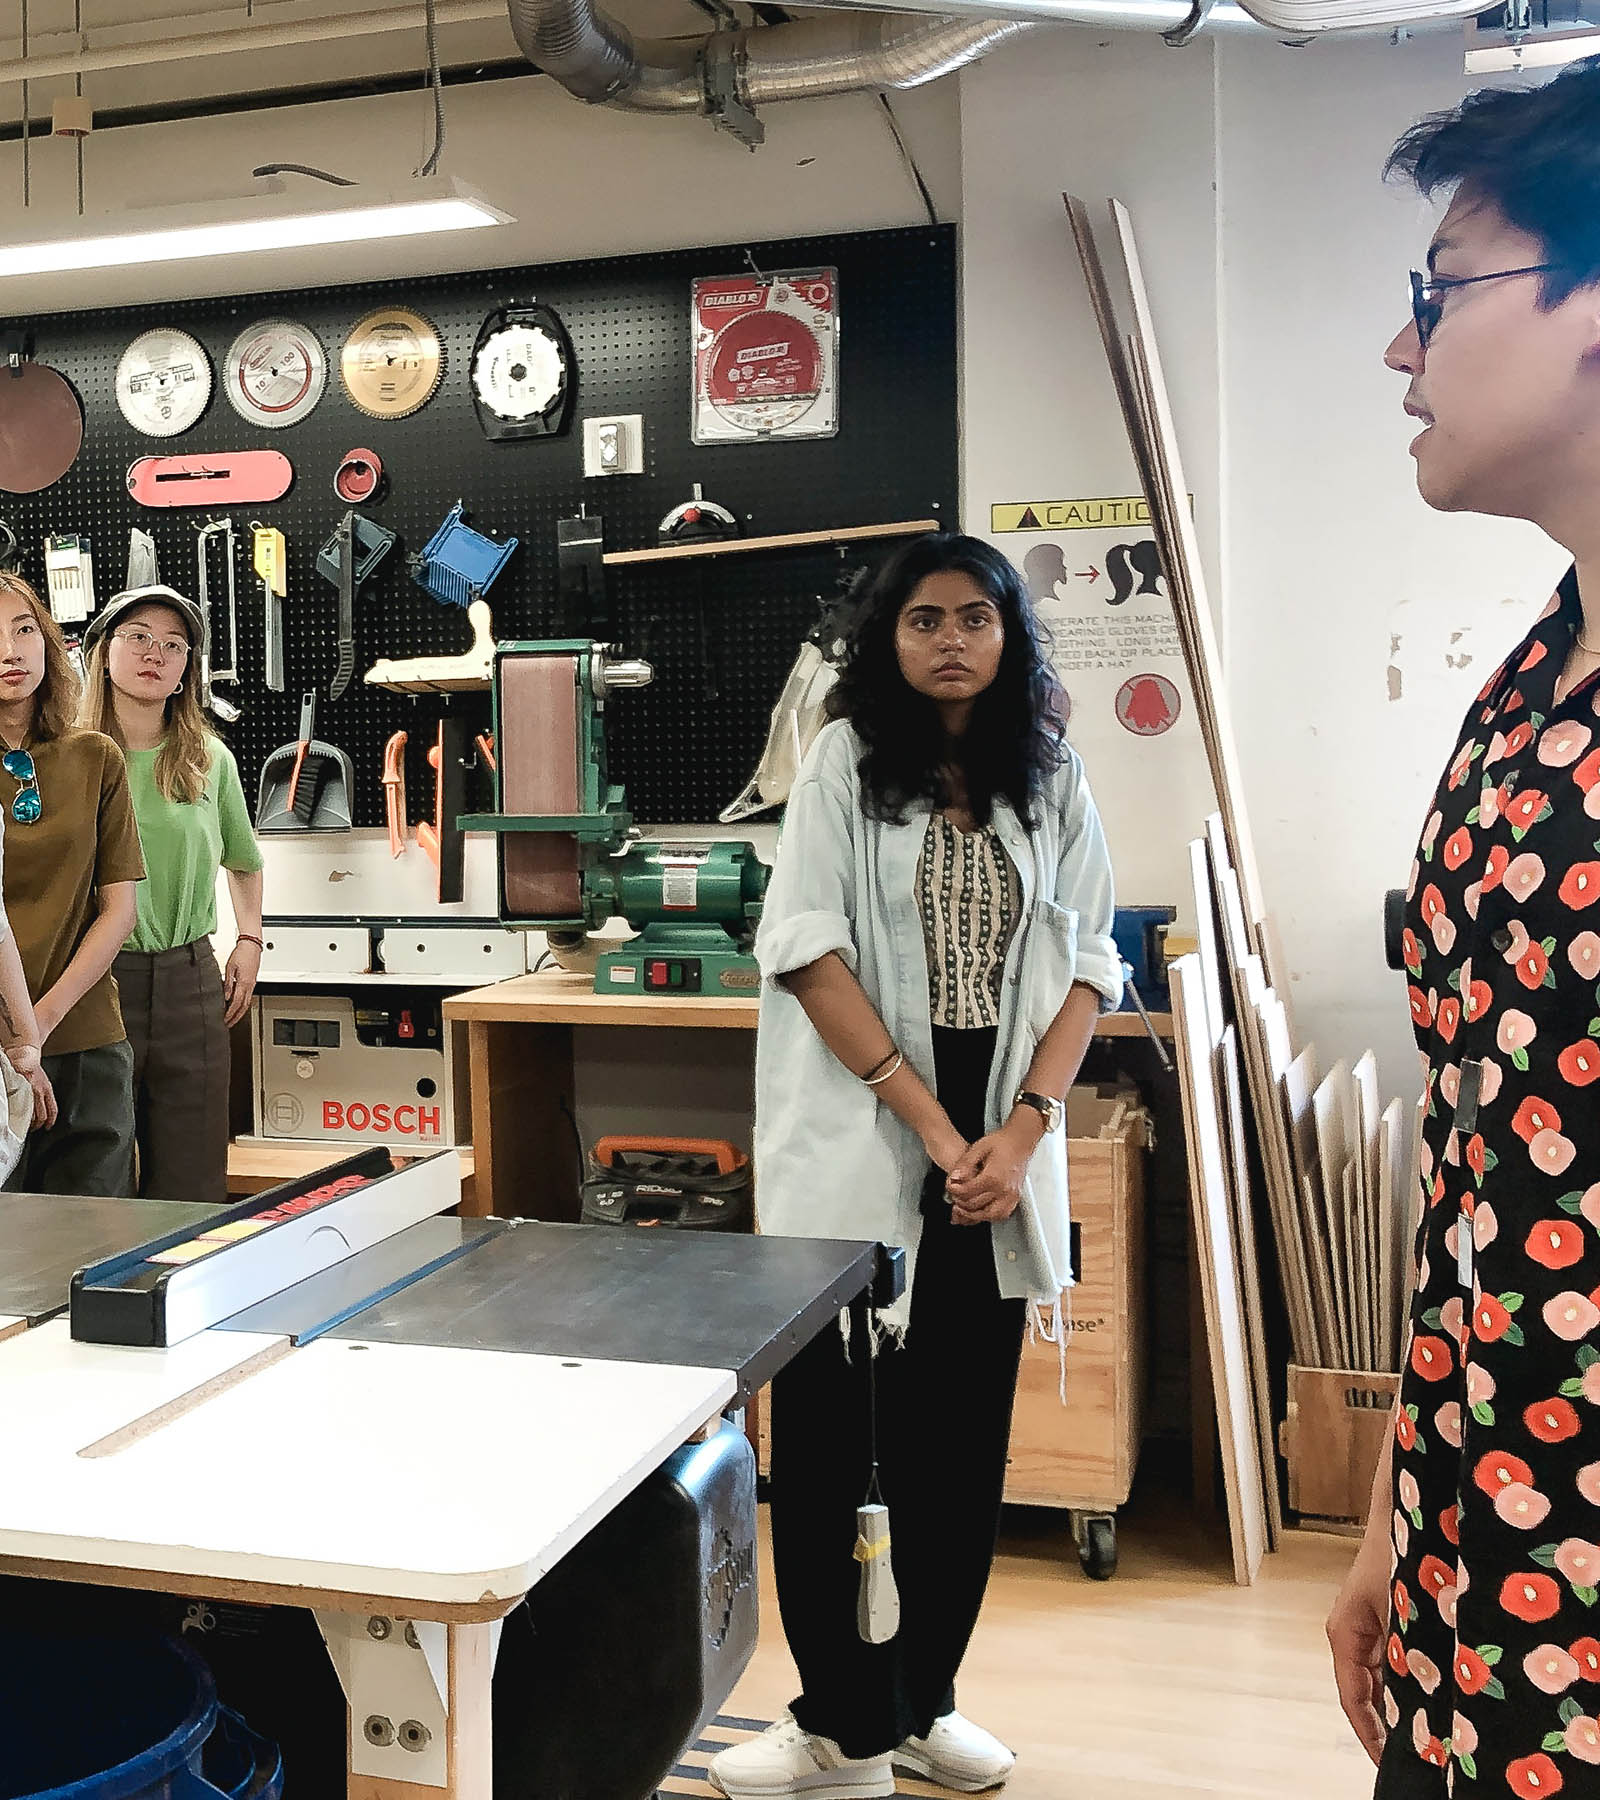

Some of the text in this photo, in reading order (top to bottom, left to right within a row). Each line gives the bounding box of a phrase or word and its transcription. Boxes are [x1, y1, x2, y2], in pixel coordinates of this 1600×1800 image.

[704, 294, 747, 307] DIABLO
[740, 347, 776, 360] DIABLO
[1046, 502, 1151, 524] CAUTIO
[1104, 615, 1131, 625] THIS
[1135, 614, 1174, 624] MACHI
[1108, 625, 1157, 636] GLOVES
[1117, 637, 1151, 647] LONG
[1085, 649, 1116, 659] BACK
[1120, 648, 1138, 658] OR
[1142, 647, 1181, 657] PLACE
[1059, 661, 1092, 671] NDER
[1108, 660, 1132, 668] HAT
[322, 1101, 440, 1135] BOSCH
